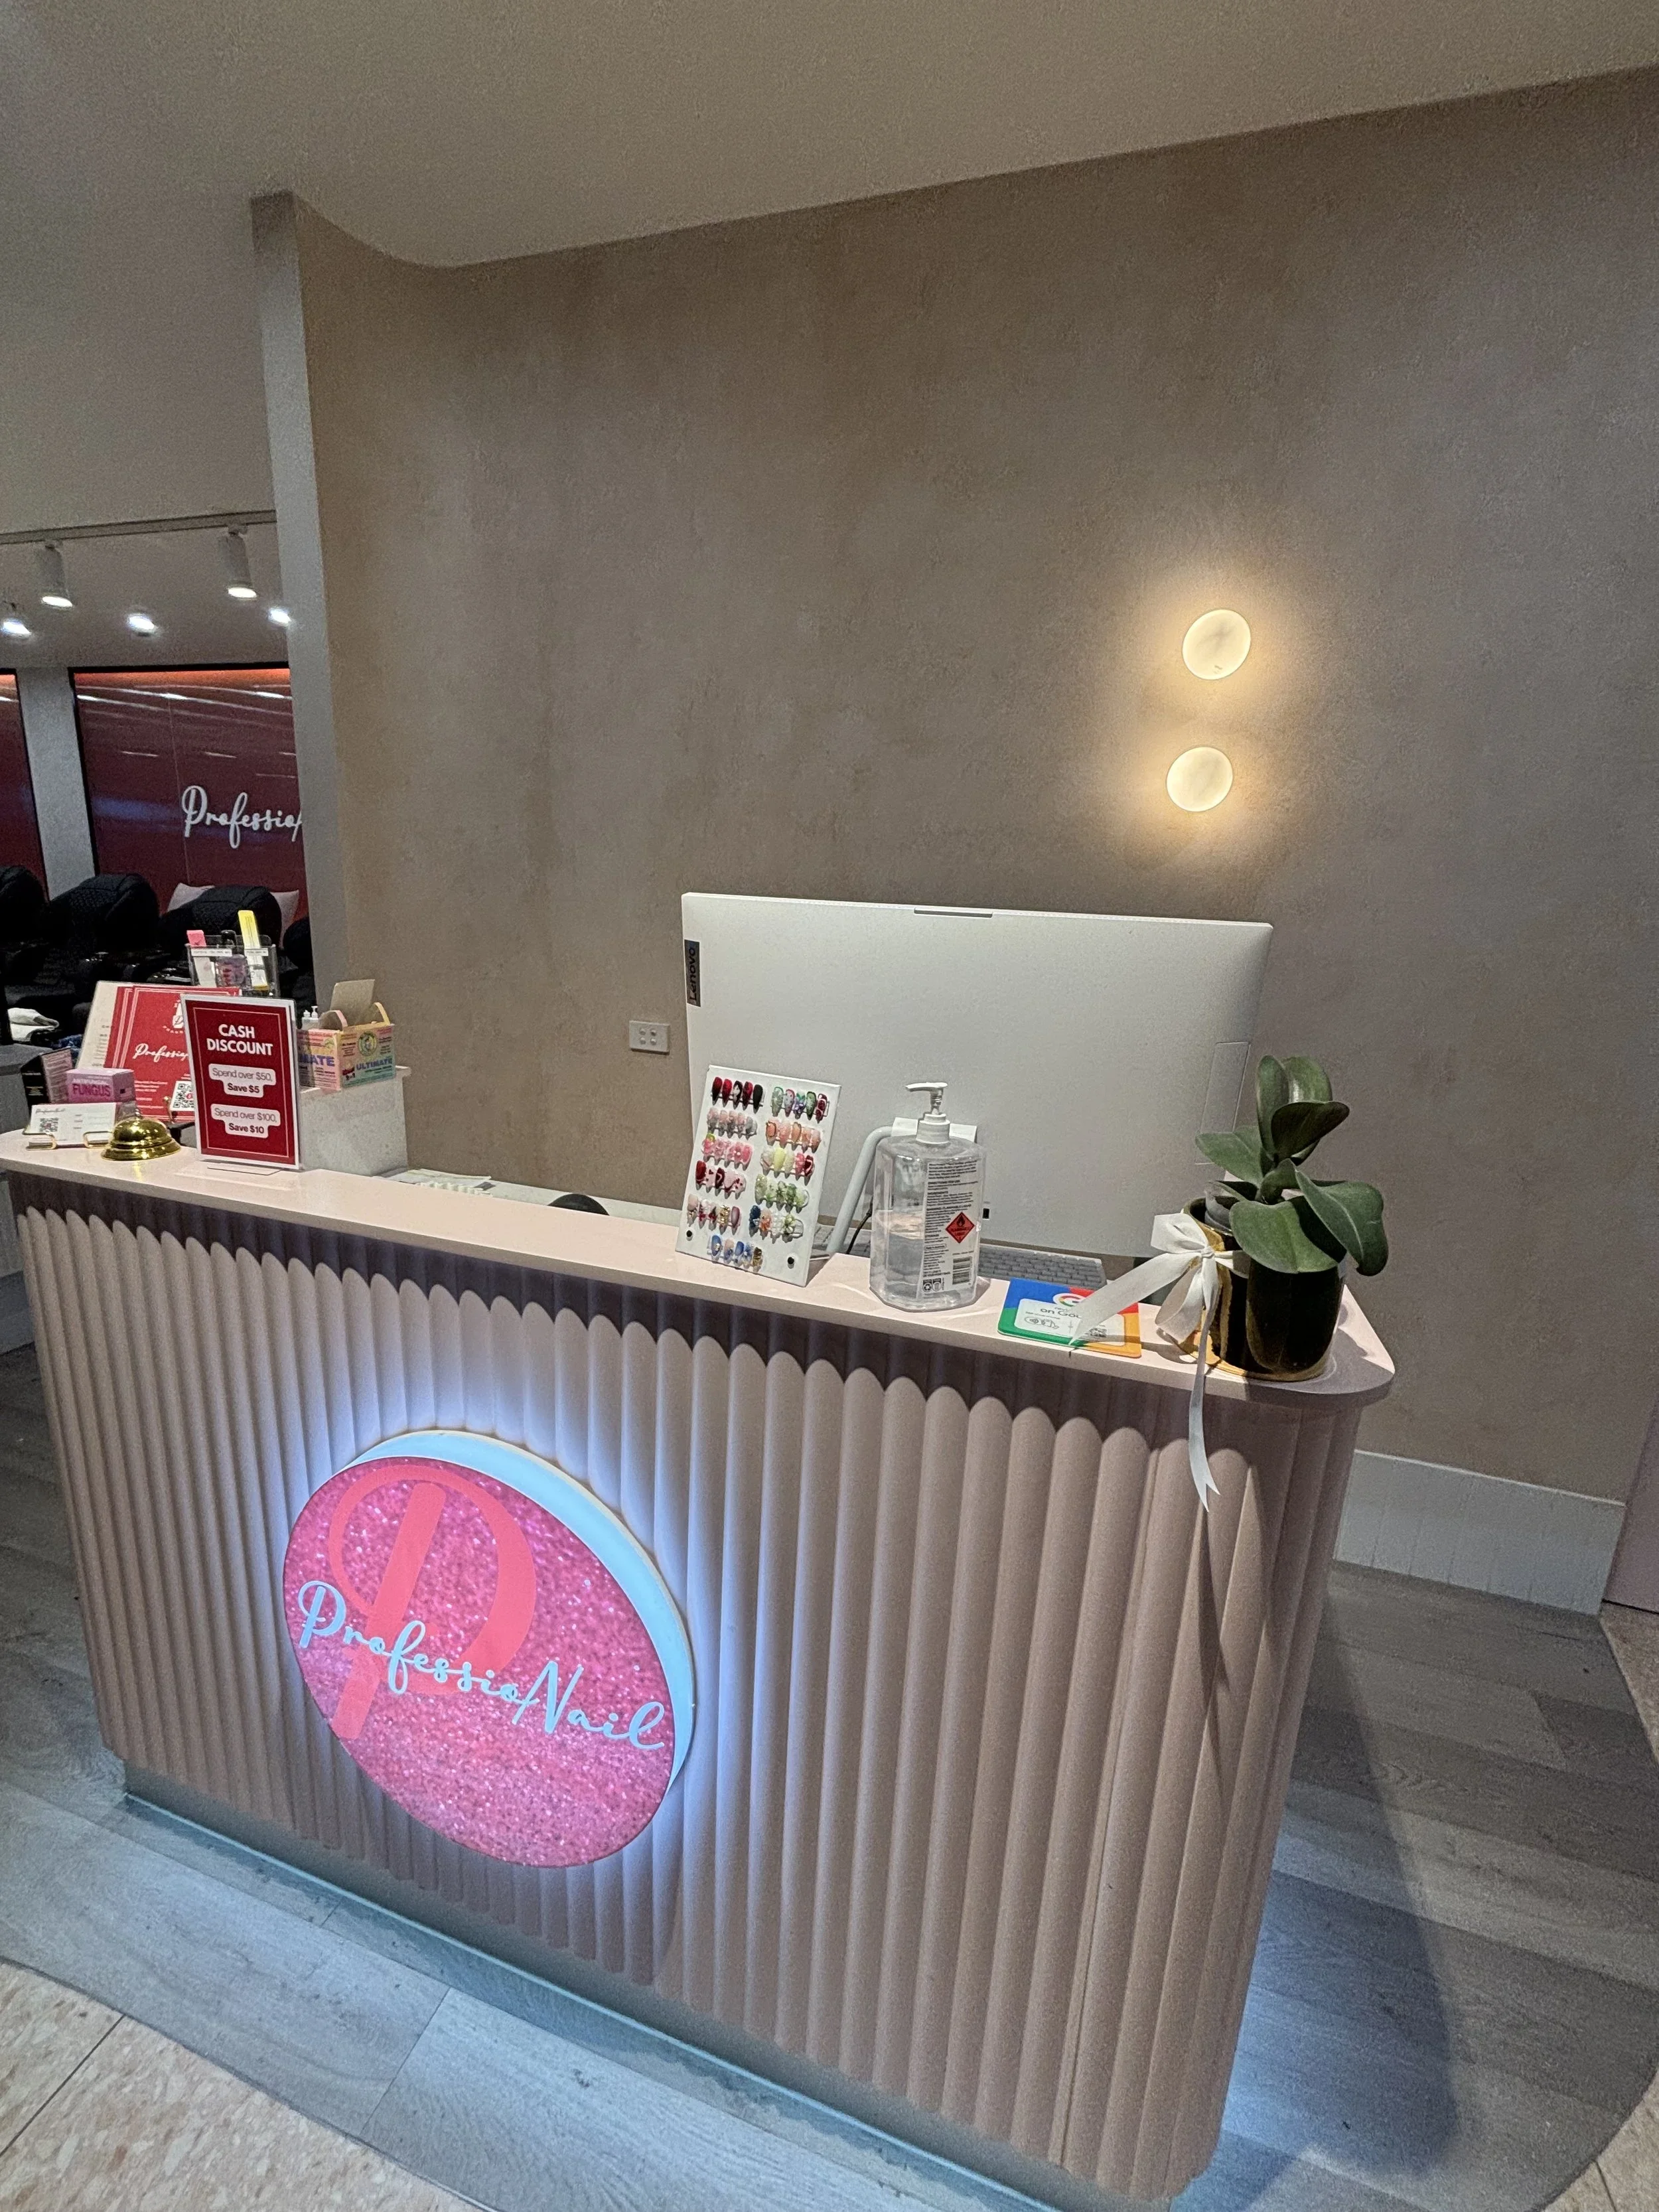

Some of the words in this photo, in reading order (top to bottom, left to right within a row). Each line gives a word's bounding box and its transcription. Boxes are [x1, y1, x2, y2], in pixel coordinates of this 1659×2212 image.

[688, 947, 697, 1001] Lenovo
[218, 1023, 255, 1039] CASH
[132, 1043, 188, 1063] Professio
[206, 1038, 273, 1056] DISCOUNT
[212, 1067, 237, 1078] Spend
[255, 1071, 273, 1082] $50,
[72, 1083, 111, 1097] FUNGUS
[227, 1082, 248, 1092] Save
[248, 1084, 260, 1094] $5
[214, 1107, 239, 1118] Spend
[257, 1112, 277, 1123] $100,
[228, 1122, 249, 1132] Save
[250, 1125, 265, 1134] $10
[297, 1580, 665, 1750] ProfessioNail
